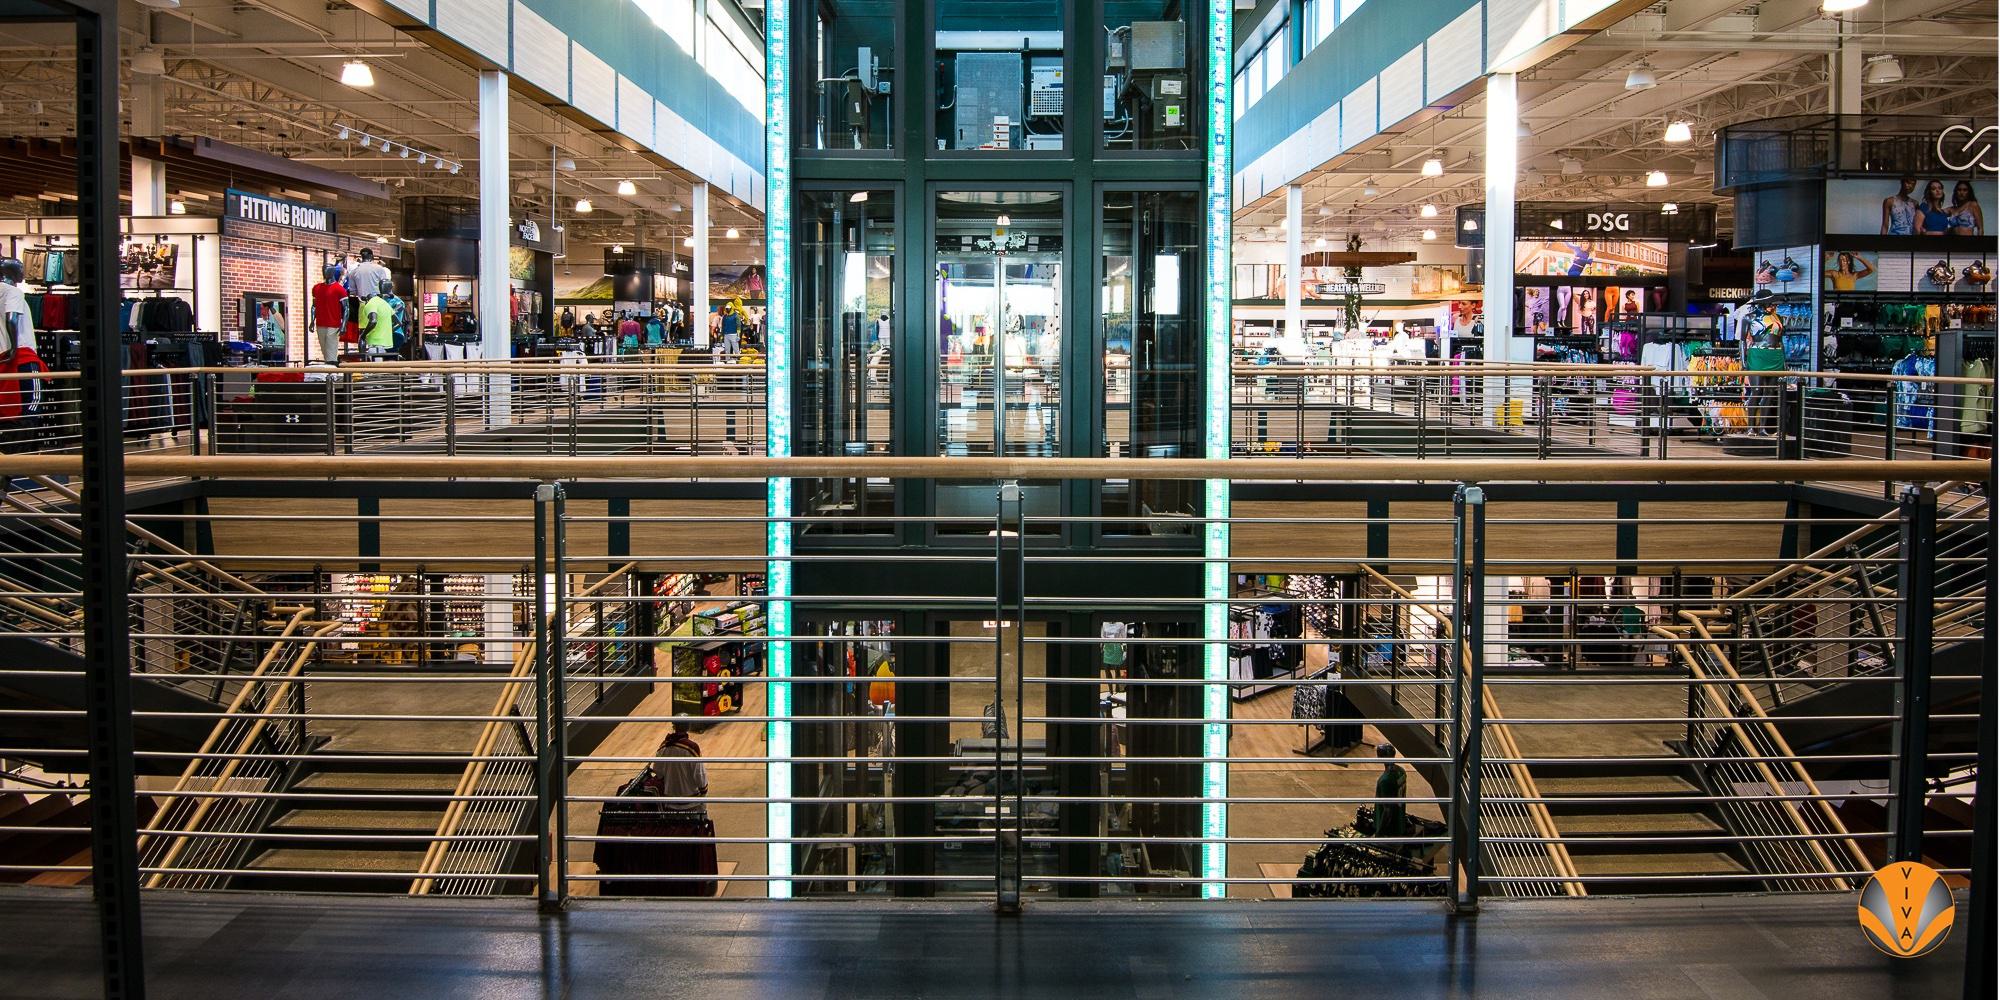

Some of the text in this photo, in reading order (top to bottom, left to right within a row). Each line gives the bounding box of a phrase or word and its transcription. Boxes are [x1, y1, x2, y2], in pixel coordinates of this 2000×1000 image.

[240, 195, 327, 231] FITTING ROOM
[1587, 212, 1629, 232] DSG
